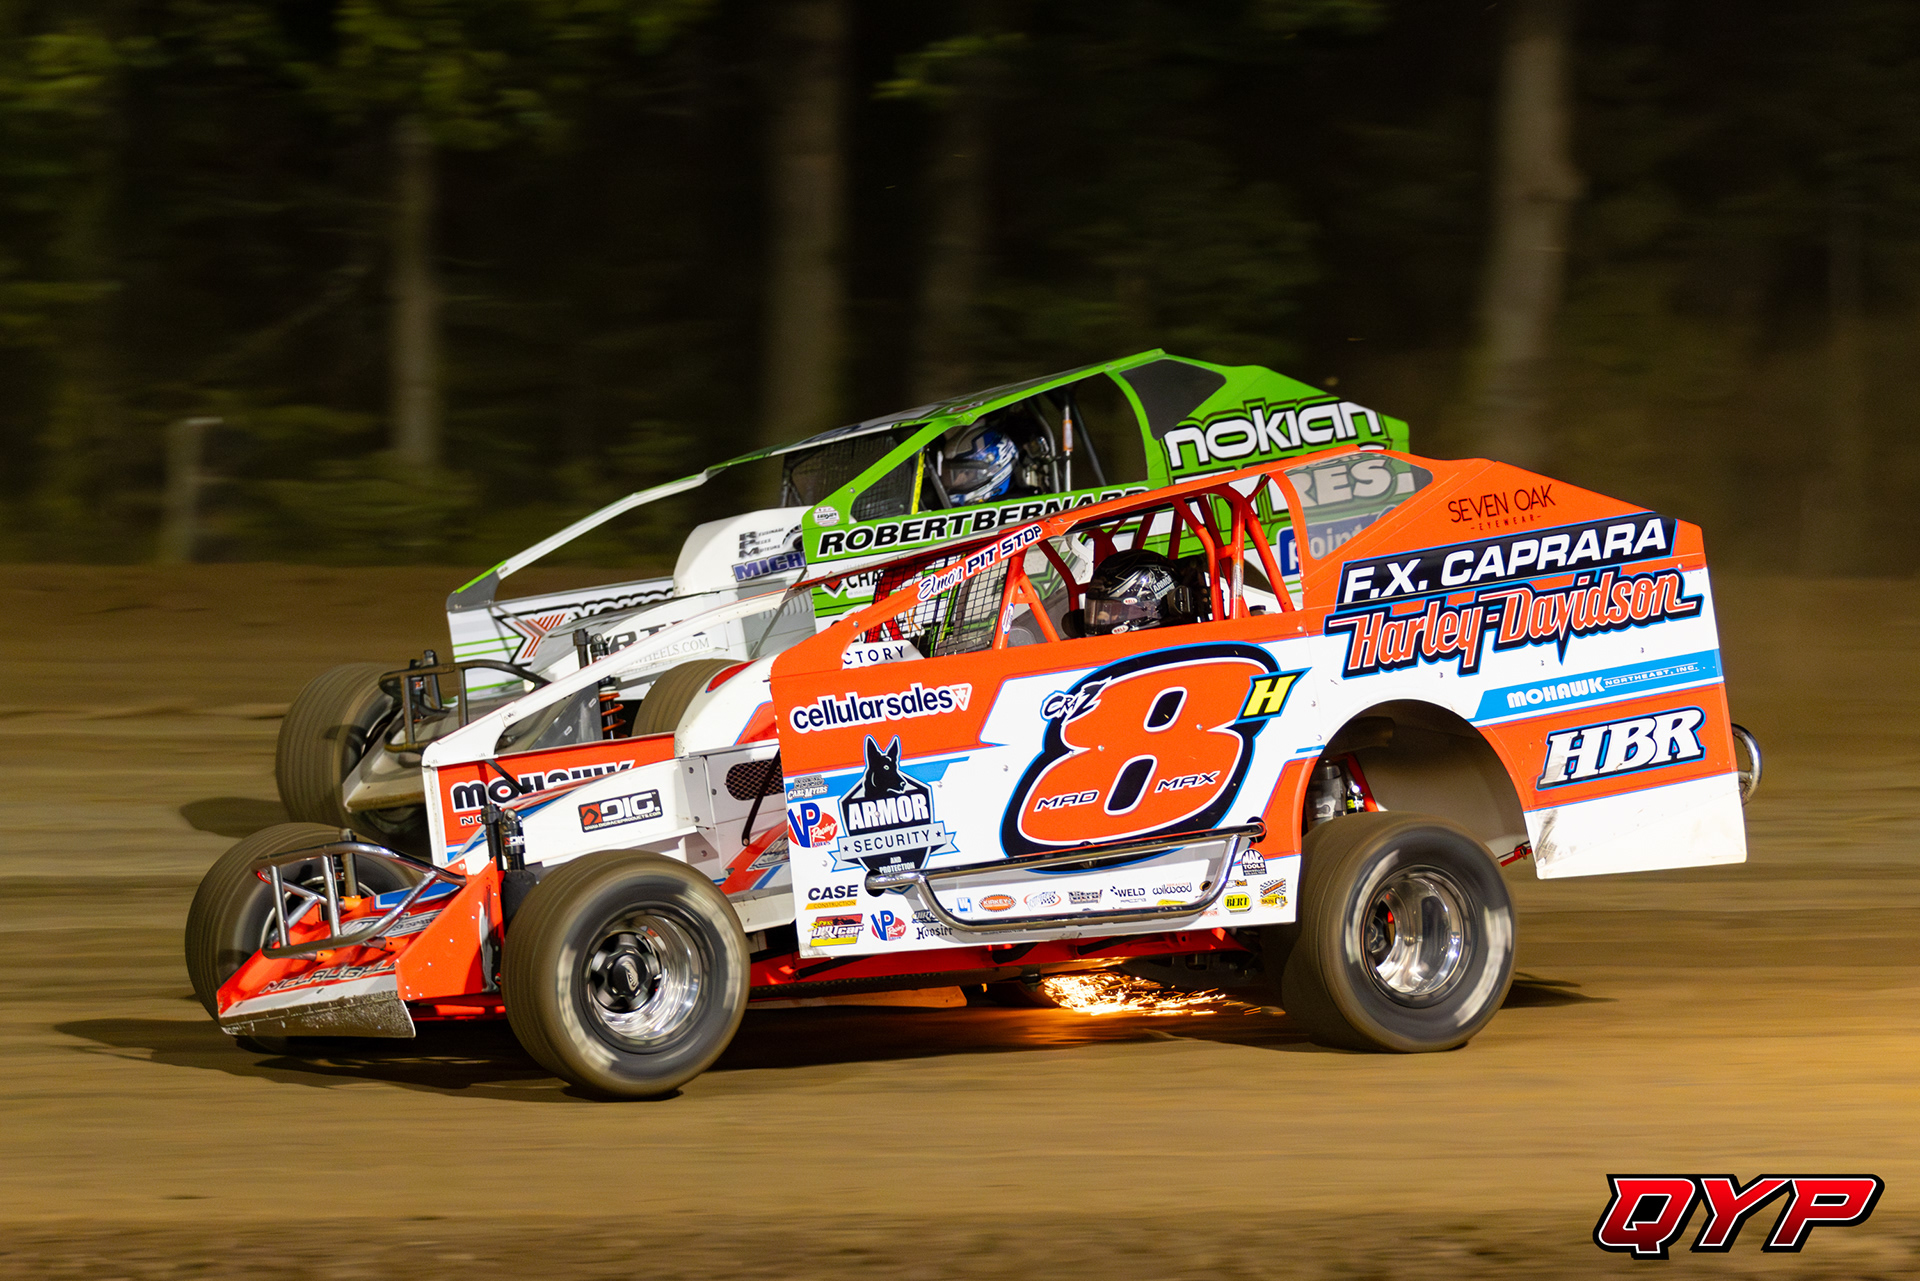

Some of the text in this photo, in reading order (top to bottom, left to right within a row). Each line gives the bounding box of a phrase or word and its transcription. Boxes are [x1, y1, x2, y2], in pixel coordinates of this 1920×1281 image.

[1163, 401, 1382, 468] nokian
[1447, 483, 1556, 523] SEVEN OAK
[1478, 513, 1535, 531] EYEWEAR
[919, 525, 1042, 600] Elmo's PIT STOP
[1343, 517, 1667, 603] F.X. CAPRARA
[1326, 569, 1699, 673] Harley-Davidson
[1241, 674, 1298, 718] H
[1506, 664, 1699, 709] MOHAWK NORTHEAST, INC.
[1008, 648, 1275, 854] 8
[1537, 708, 1704, 787] HBR
[1156, 771, 1219, 792] MAX
[848, 793, 930, 831] ARMOR
[1035, 791, 1099, 811] MAD
[787, 803, 821, 848] VP
[812, 822, 838, 843] Racing
[853, 829, 930, 853] SECURITY
[879, 861, 916, 874] PROTECTION
[890, 856, 902, 865] AND
[1242, 849, 1265, 864] MAC
[807, 884, 859, 901] CASE
[982, 897, 1009, 906] KIRKEY
[1117, 887, 1146, 898] WELD
[1226, 896, 1248, 907] BERT
[813, 900, 856, 909] CONSTRUCTION
[870, 910, 895, 941] VP
[915, 924, 954, 940] Hoosier
